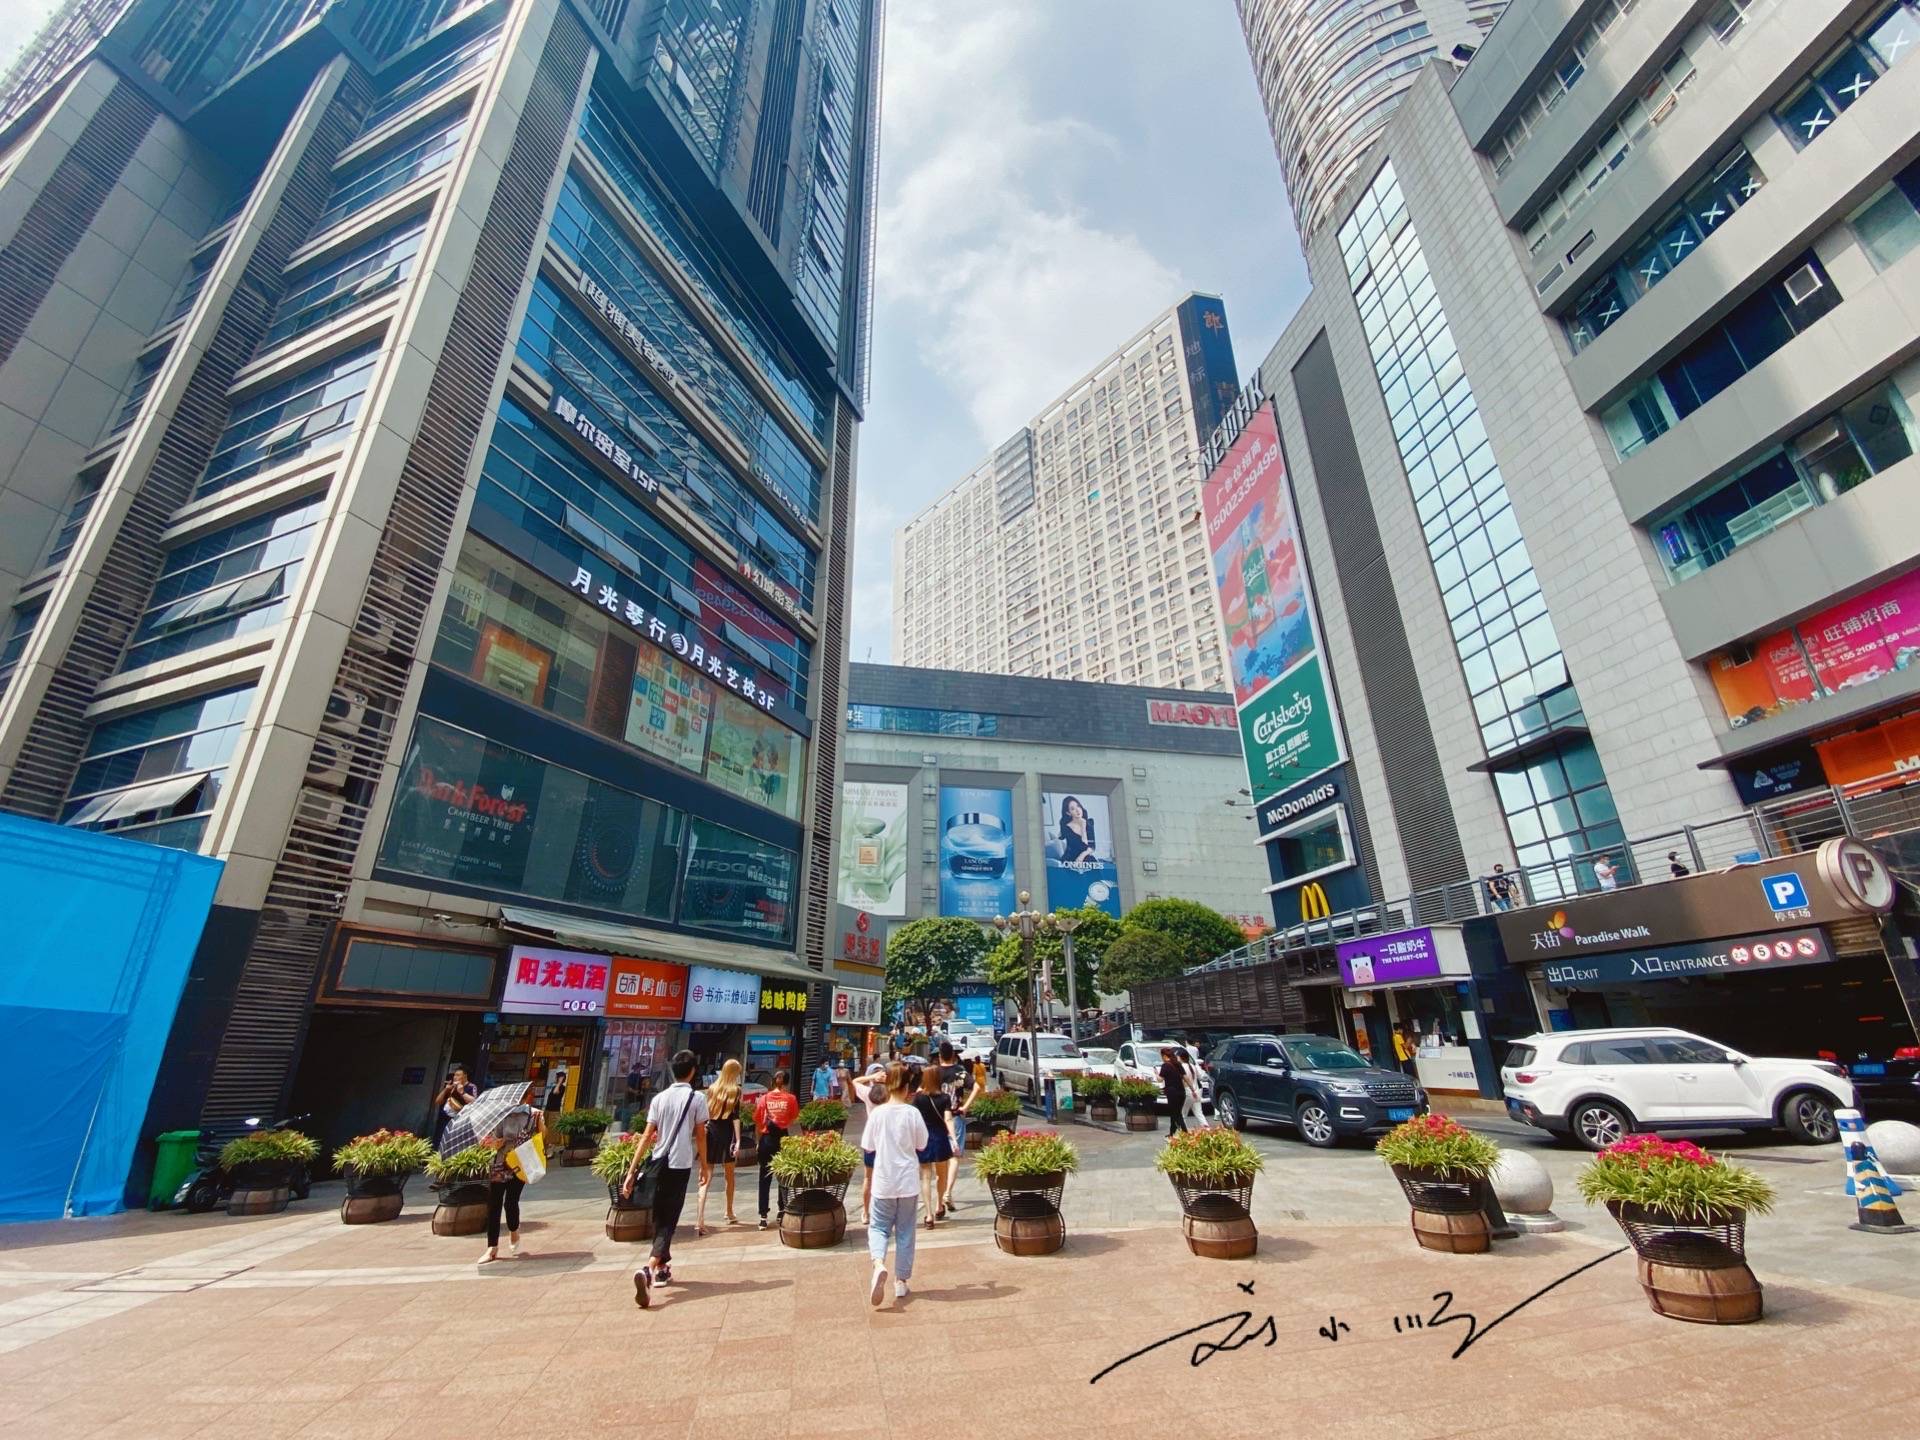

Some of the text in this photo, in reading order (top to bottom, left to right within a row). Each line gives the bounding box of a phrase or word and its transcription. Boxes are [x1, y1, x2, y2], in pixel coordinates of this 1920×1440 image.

[1208, 443, 1278, 536] 15002339499
[1823, 602, 1901, 642] 旺铺招商
[571, 566, 667, 643] 月光琴行
[690, 643, 775, 711] 月光艺校3F
[1253, 693, 1313, 744] Carlsberg
[1267, 783, 1336, 825] McDonald's
[492, 818, 514, 832] TRIBE
[1058, 861, 1104, 871] LONGINES
[1772, 881, 1795, 905] P
[1774, 908, 1812, 922] 停车场
[1380, 938, 1426, 955] 一只酸奶牛
[1530, 926, 1650, 950] 天街 Paradise Walk
[515, 957, 608, 992] 阳光烟酒
[1547, 954, 1730, 983] 出口 EXIT 入口 ENTRANCE
[761, 990, 807, 1012] 绝味鸭脖
